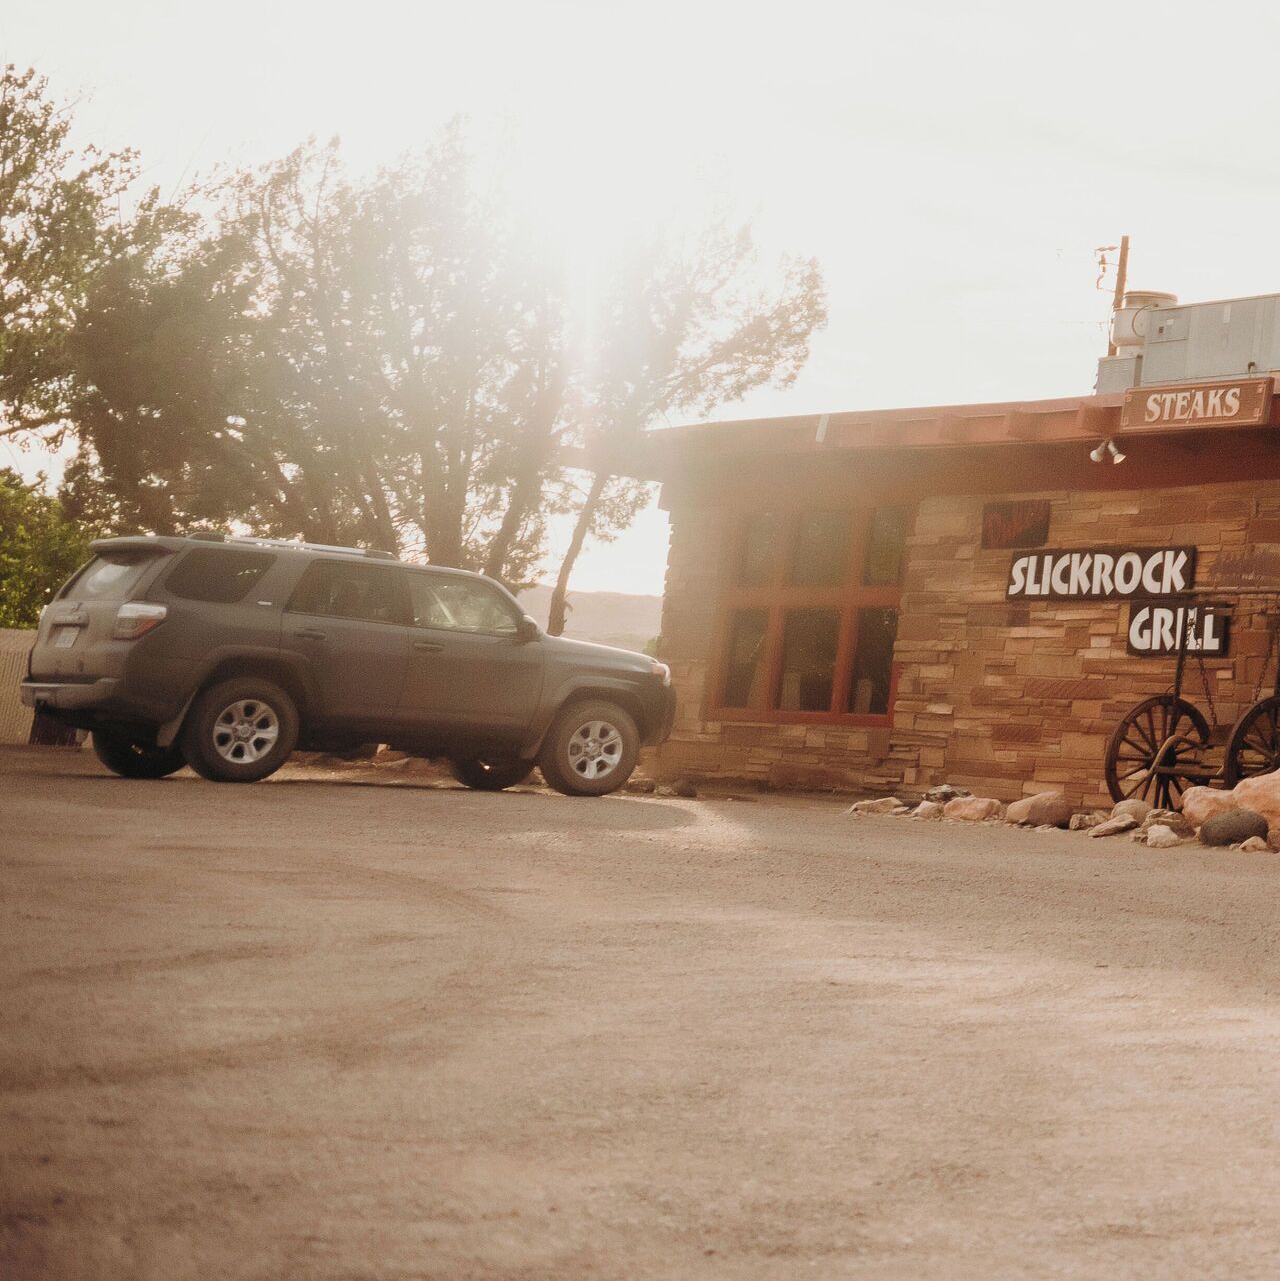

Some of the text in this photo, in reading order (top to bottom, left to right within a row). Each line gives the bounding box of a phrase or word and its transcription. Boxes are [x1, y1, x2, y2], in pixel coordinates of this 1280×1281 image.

[1144, 387, 1241, 423] STEAKS
[1008, 550, 1188, 596] SLICKROCK
[1129, 605, 1221, 652] GRILL
